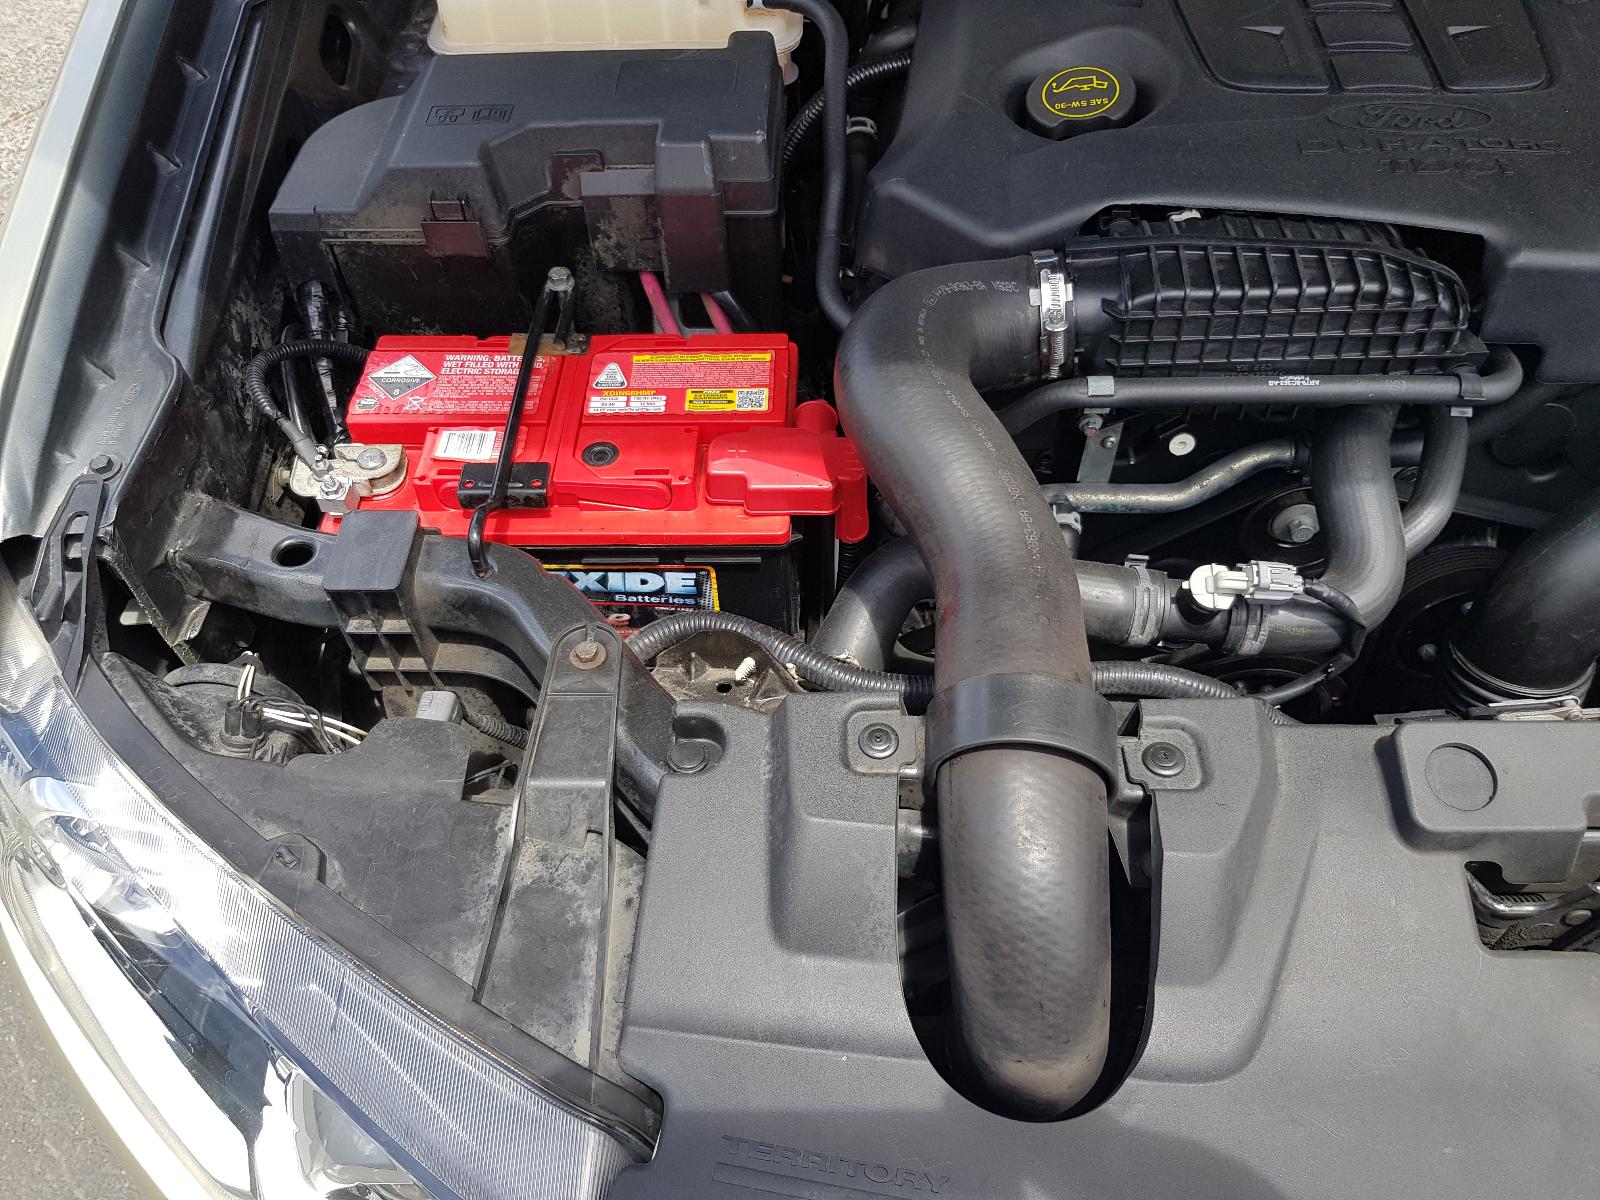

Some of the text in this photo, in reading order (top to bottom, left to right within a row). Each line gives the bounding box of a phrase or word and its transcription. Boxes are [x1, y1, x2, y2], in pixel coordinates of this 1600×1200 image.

[1054, 97, 1109, 110] SAE 5W-30
[1357, 103, 1470, 129] Ford
[446, 354, 546, 363] WARNING: BATTES,
[440, 367, 482, 375] ELECTRIC
[392, 388, 401, 396] 8
[552, 571, 697, 594] XIDE
[615, 593, 697, 606] Batteries
[722, 1135, 950, 1193] TERRITORY
